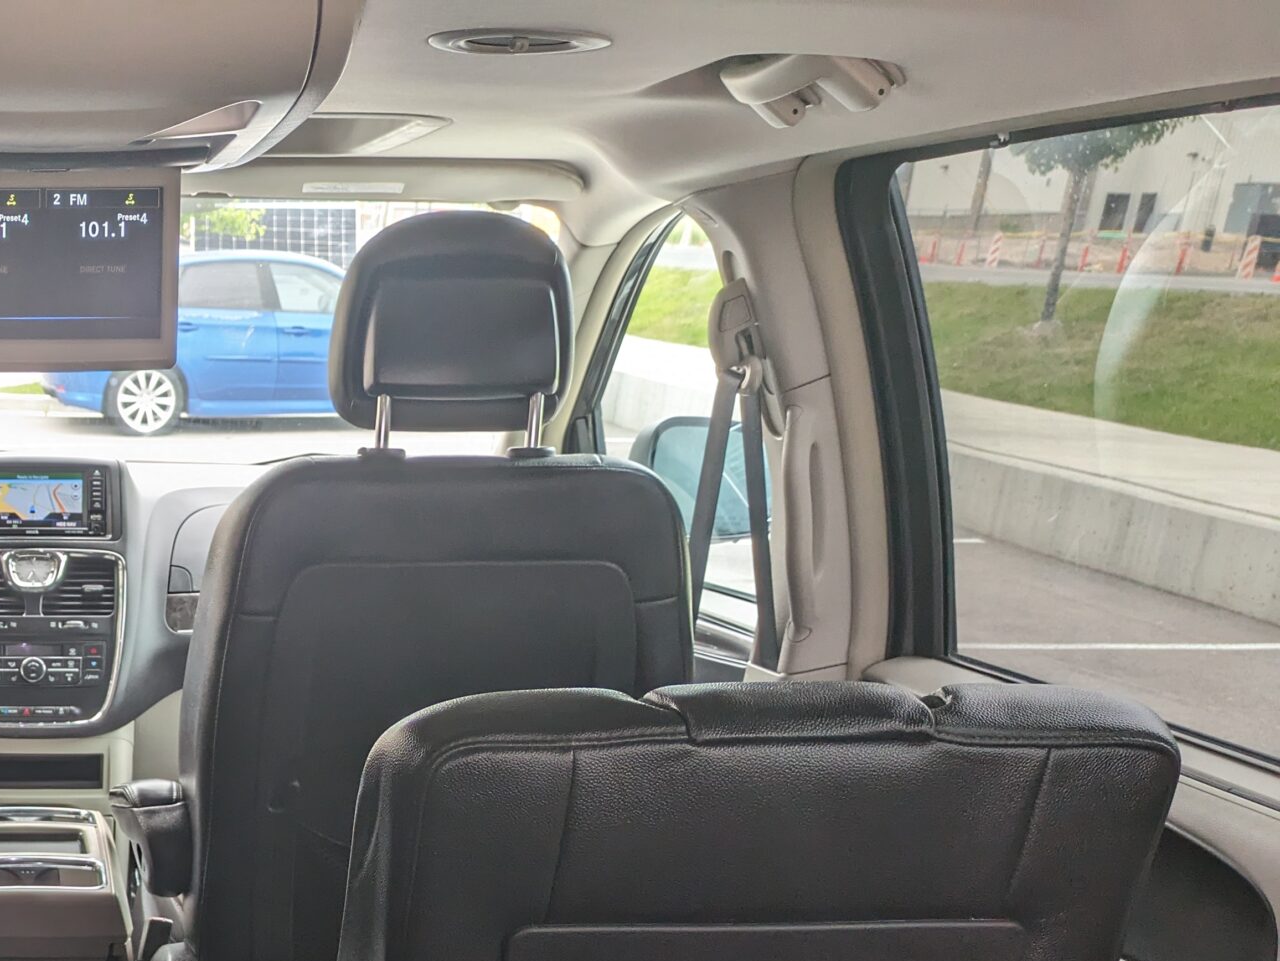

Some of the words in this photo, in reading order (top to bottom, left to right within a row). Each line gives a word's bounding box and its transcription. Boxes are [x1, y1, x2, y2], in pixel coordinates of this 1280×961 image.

[53, 193, 61, 206] 2
[69, 193, 87, 206] FM
[79, 220, 126, 239] 101.1
